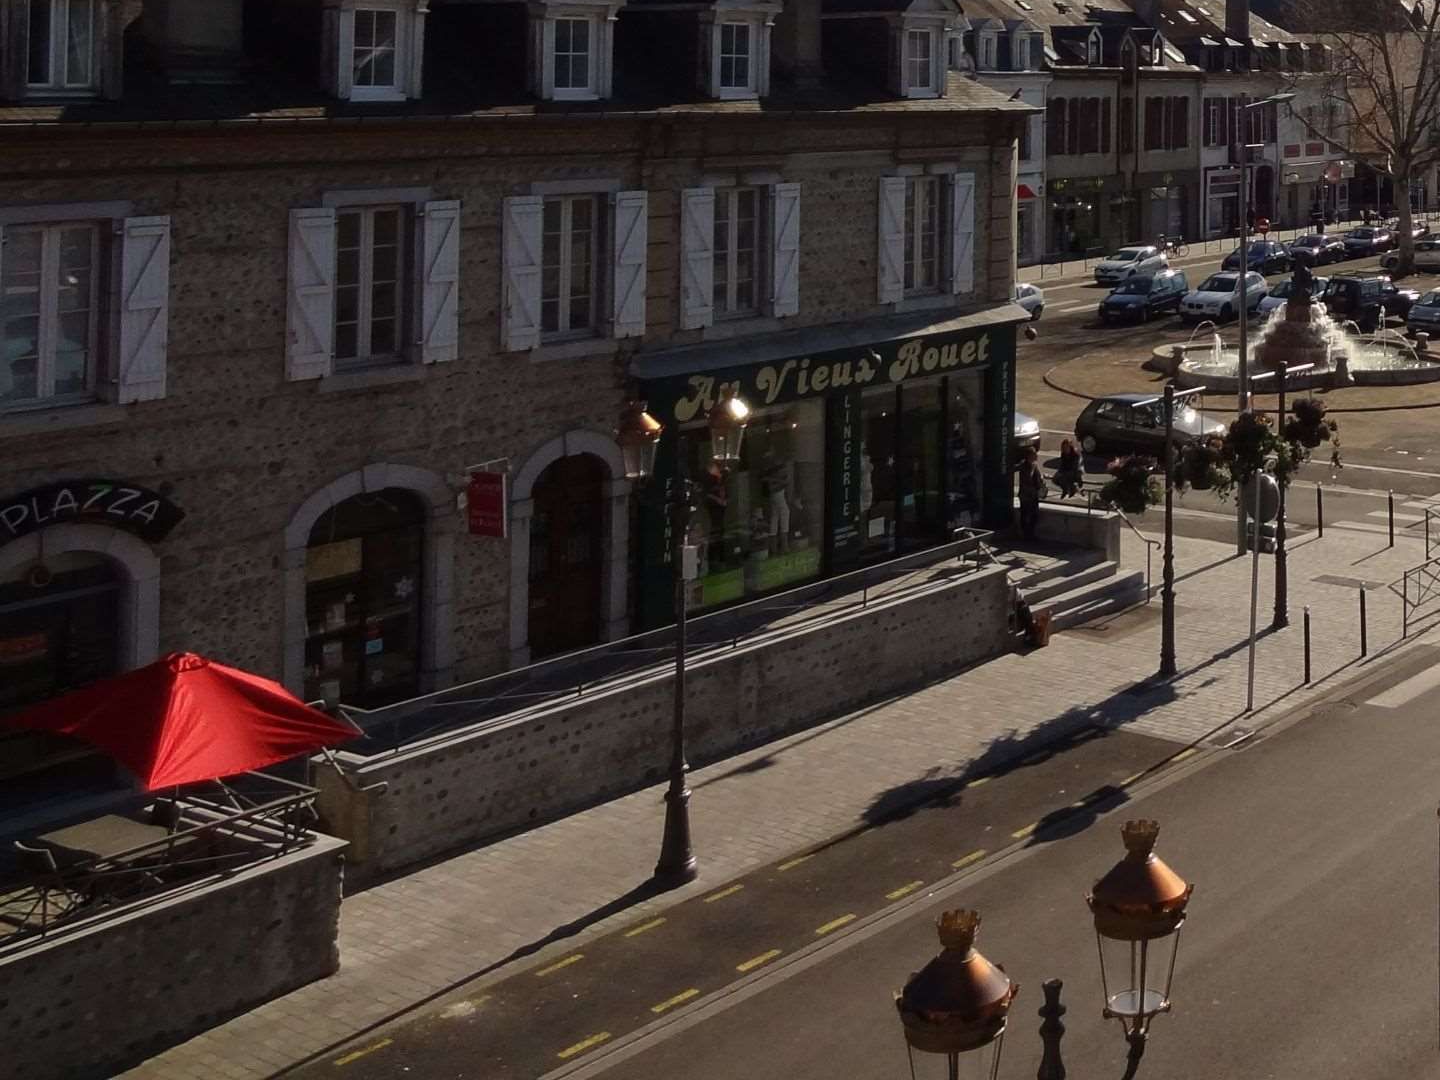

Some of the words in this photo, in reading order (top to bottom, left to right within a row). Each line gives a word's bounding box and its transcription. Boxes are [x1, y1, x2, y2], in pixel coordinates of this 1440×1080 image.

[674, 374, 742, 421] Au
[756, 357, 877, 405] Vieux
[888, 332, 991, 382] Rouet
[842, 394, 852, 517] LINGERIE
[0, 488, 161, 535] PLAZZA
